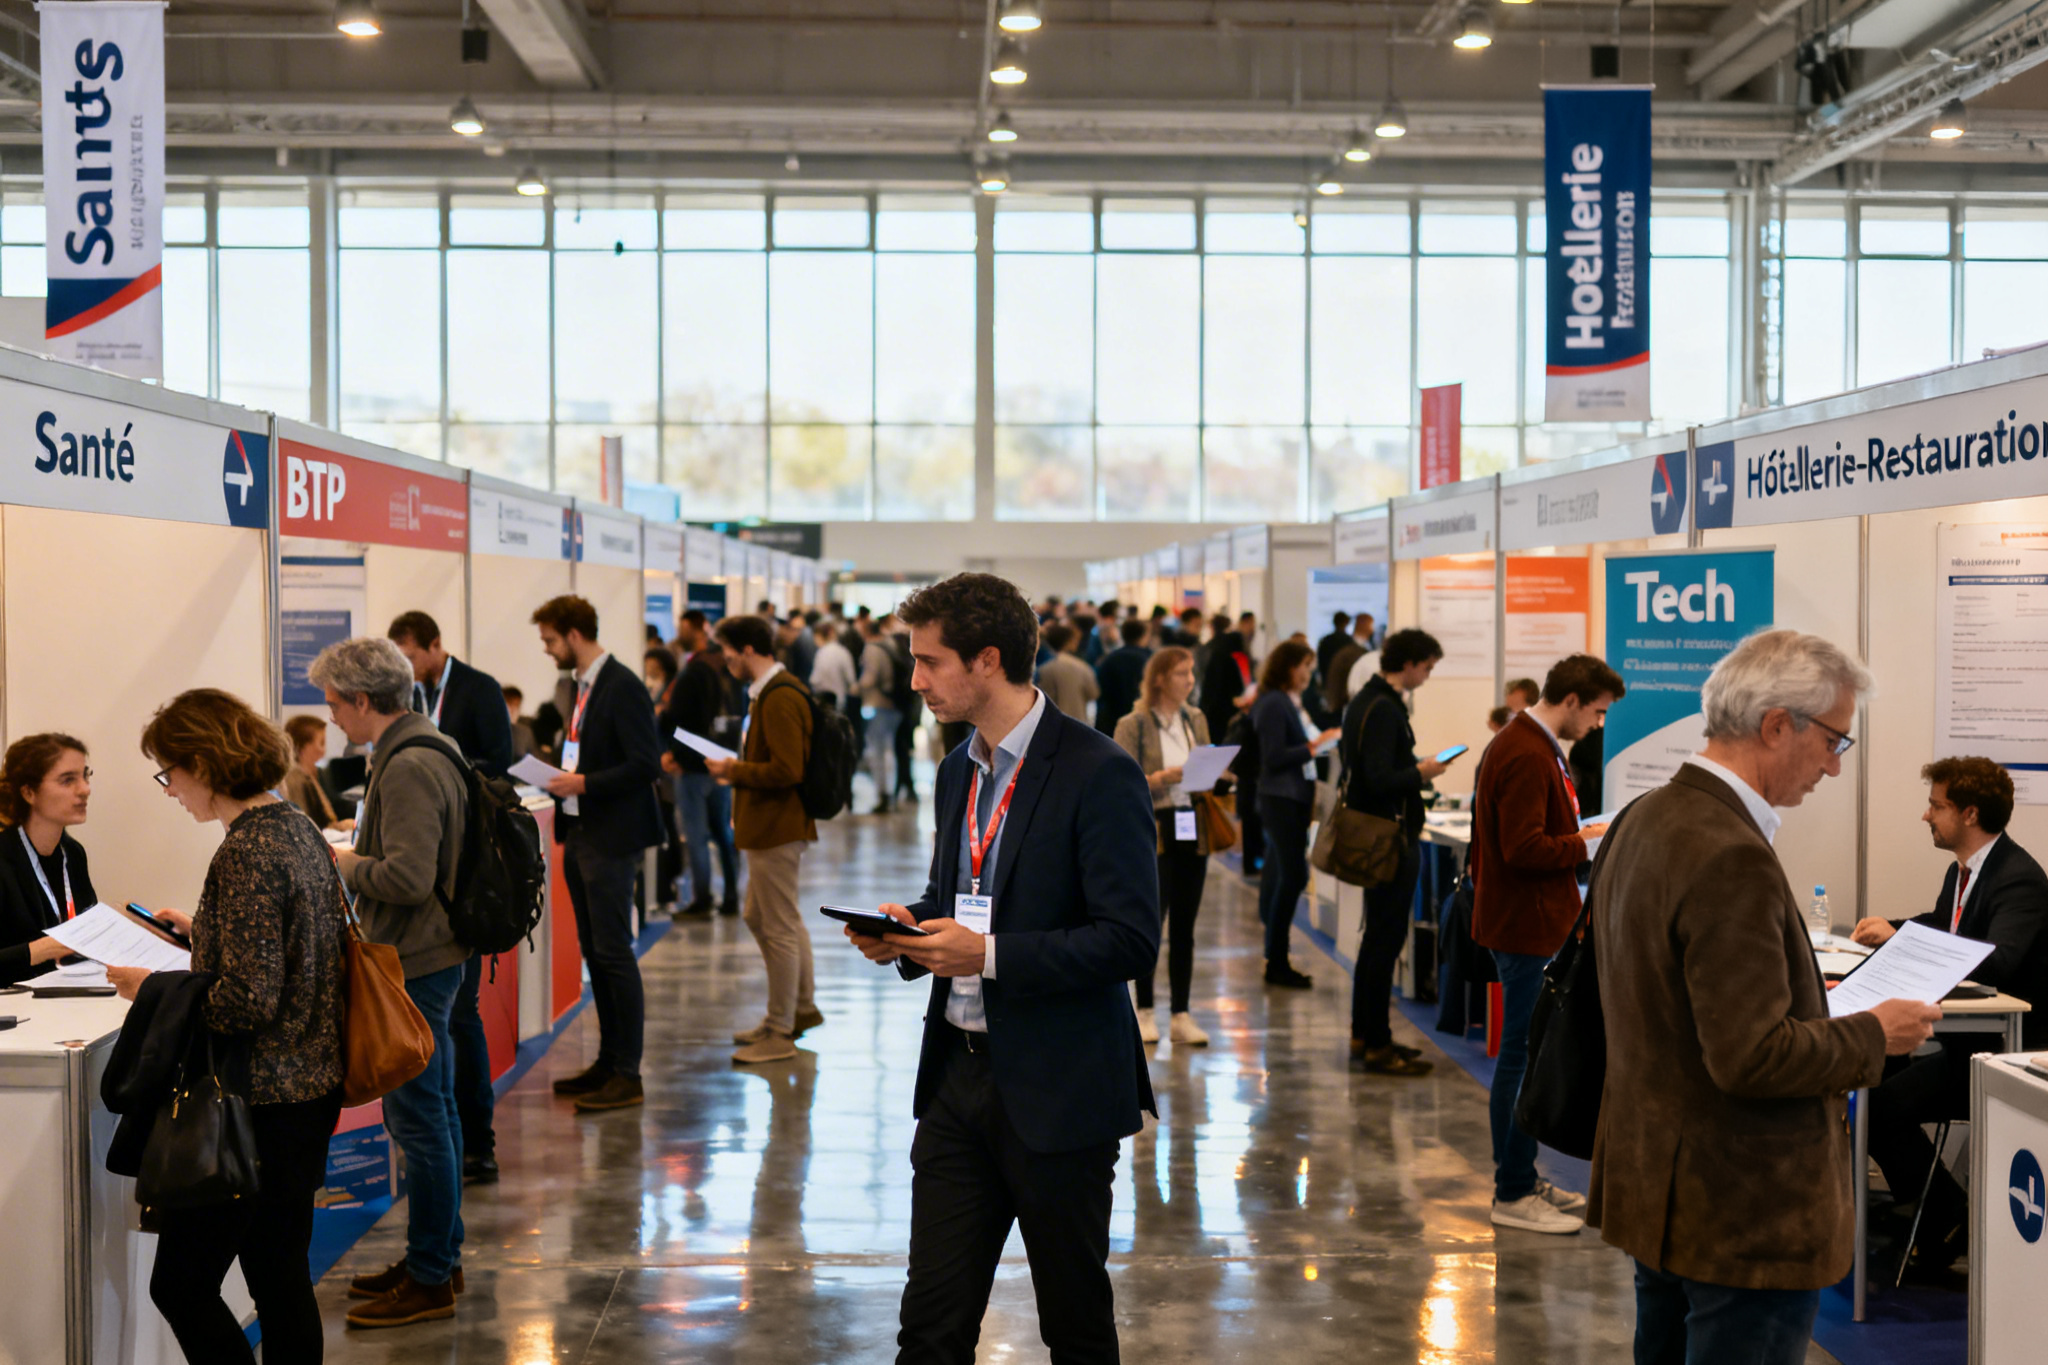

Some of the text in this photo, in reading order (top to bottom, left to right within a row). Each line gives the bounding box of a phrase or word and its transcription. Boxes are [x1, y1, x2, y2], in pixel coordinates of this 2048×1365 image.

[35, 411, 135, 483] Santé
[287, 455, 346, 521] BTP
[1625, 568, 1735, 623] Tech
